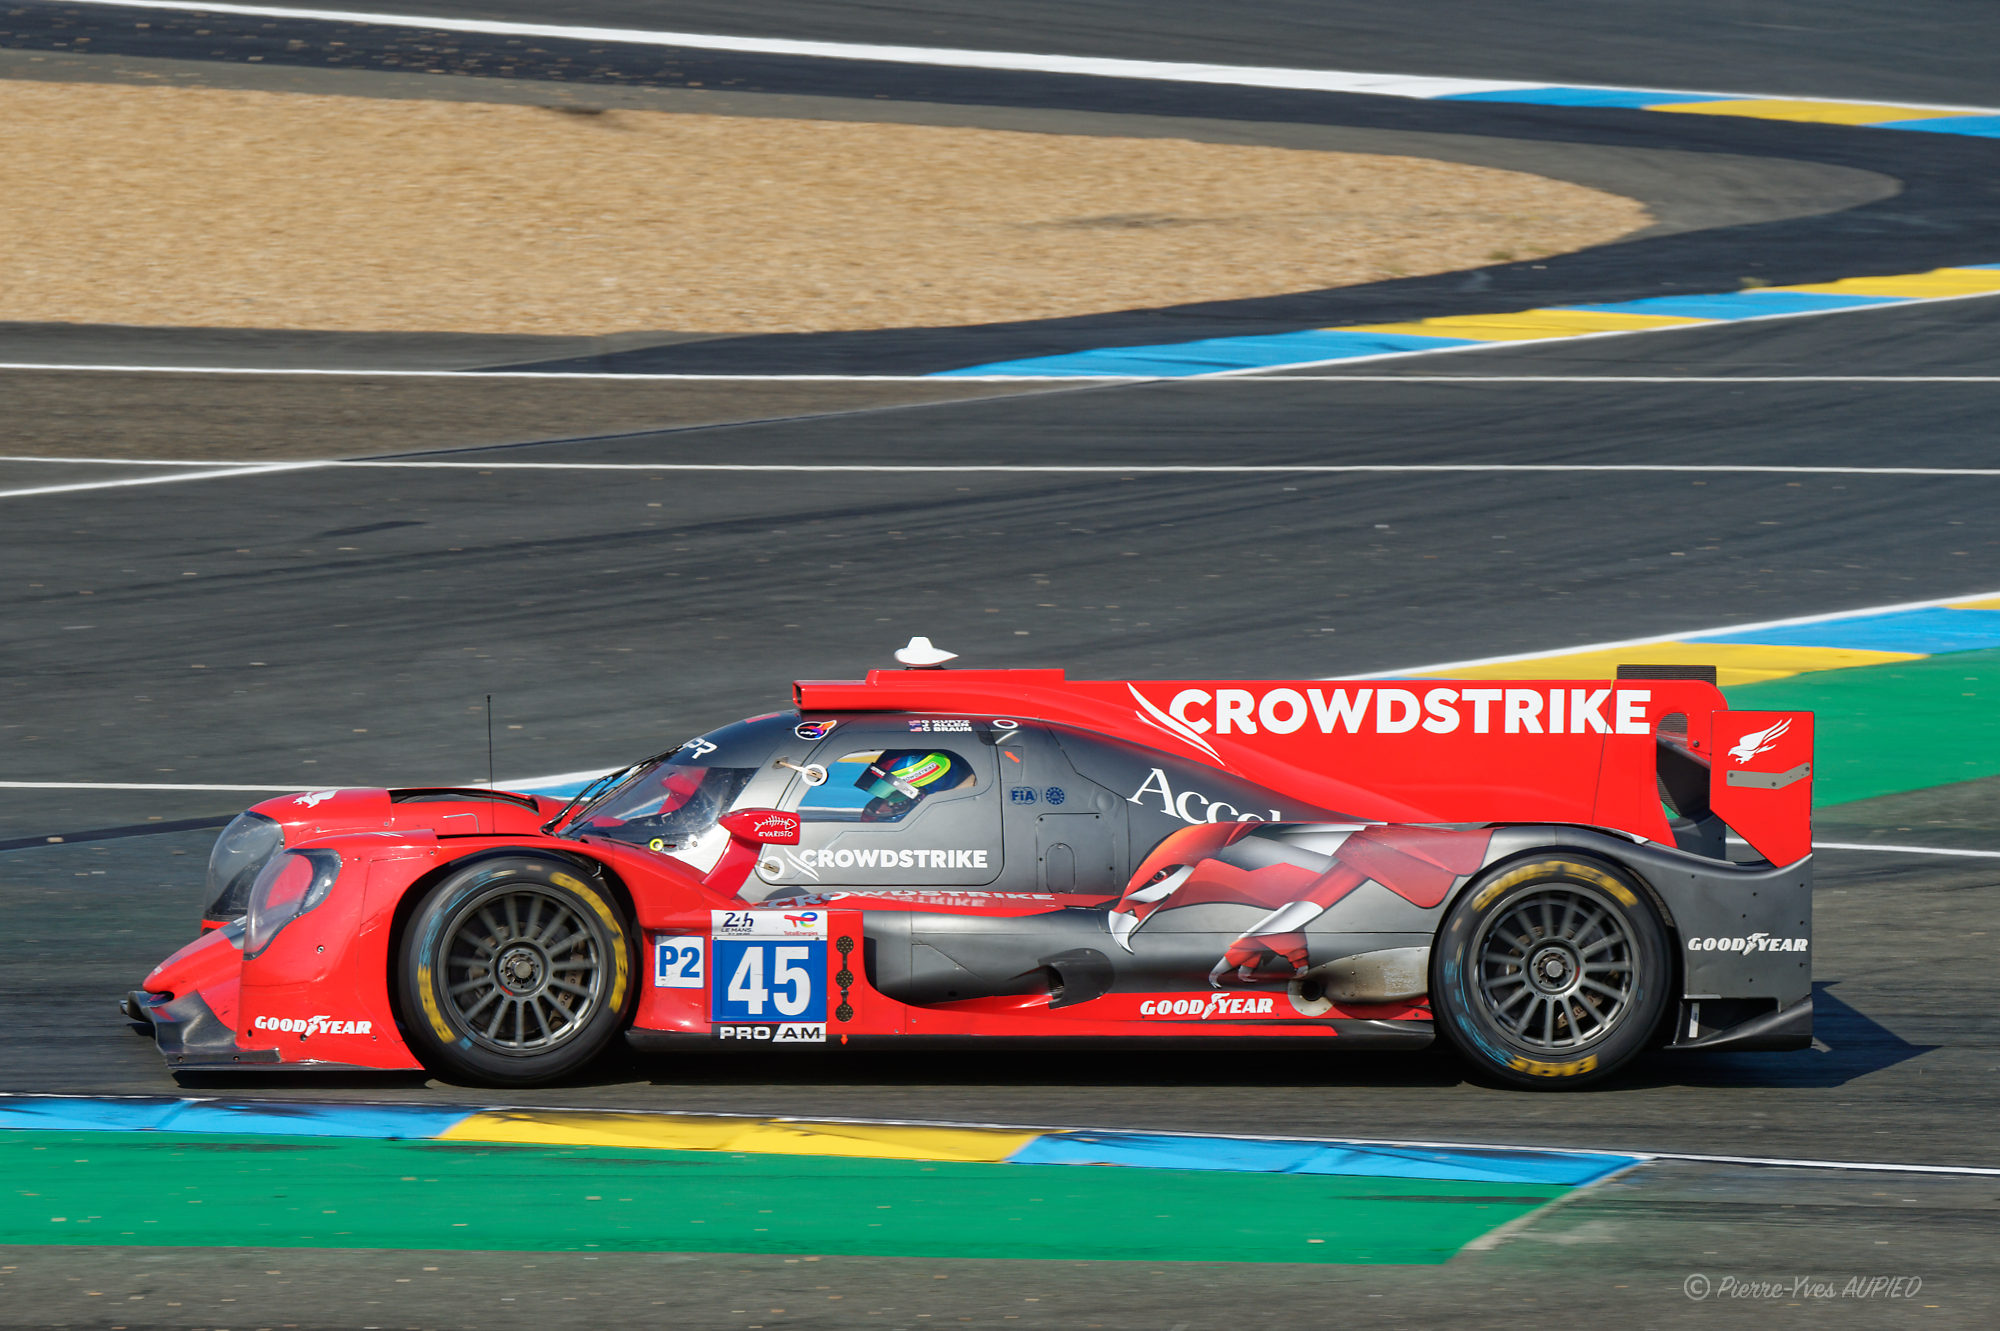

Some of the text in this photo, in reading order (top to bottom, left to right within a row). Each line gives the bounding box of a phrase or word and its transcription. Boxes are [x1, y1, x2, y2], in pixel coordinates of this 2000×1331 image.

[1168, 687, 1652, 735] CROWDSTRIKE
[799, 849, 988, 869] CROWDSTRIKE
[767, 890, 1055, 908] CROWDSTRIKE
[1687, 936, 1809, 953] GOODYEAR
[658, 944, 701, 979] P2
[727, 946, 812, 1016] 45
[1139, 997, 1274, 1016] GOODYEAR
[254, 1015, 373, 1035] GOODYEAR
[719, 1026, 821, 1040] PRO AM
